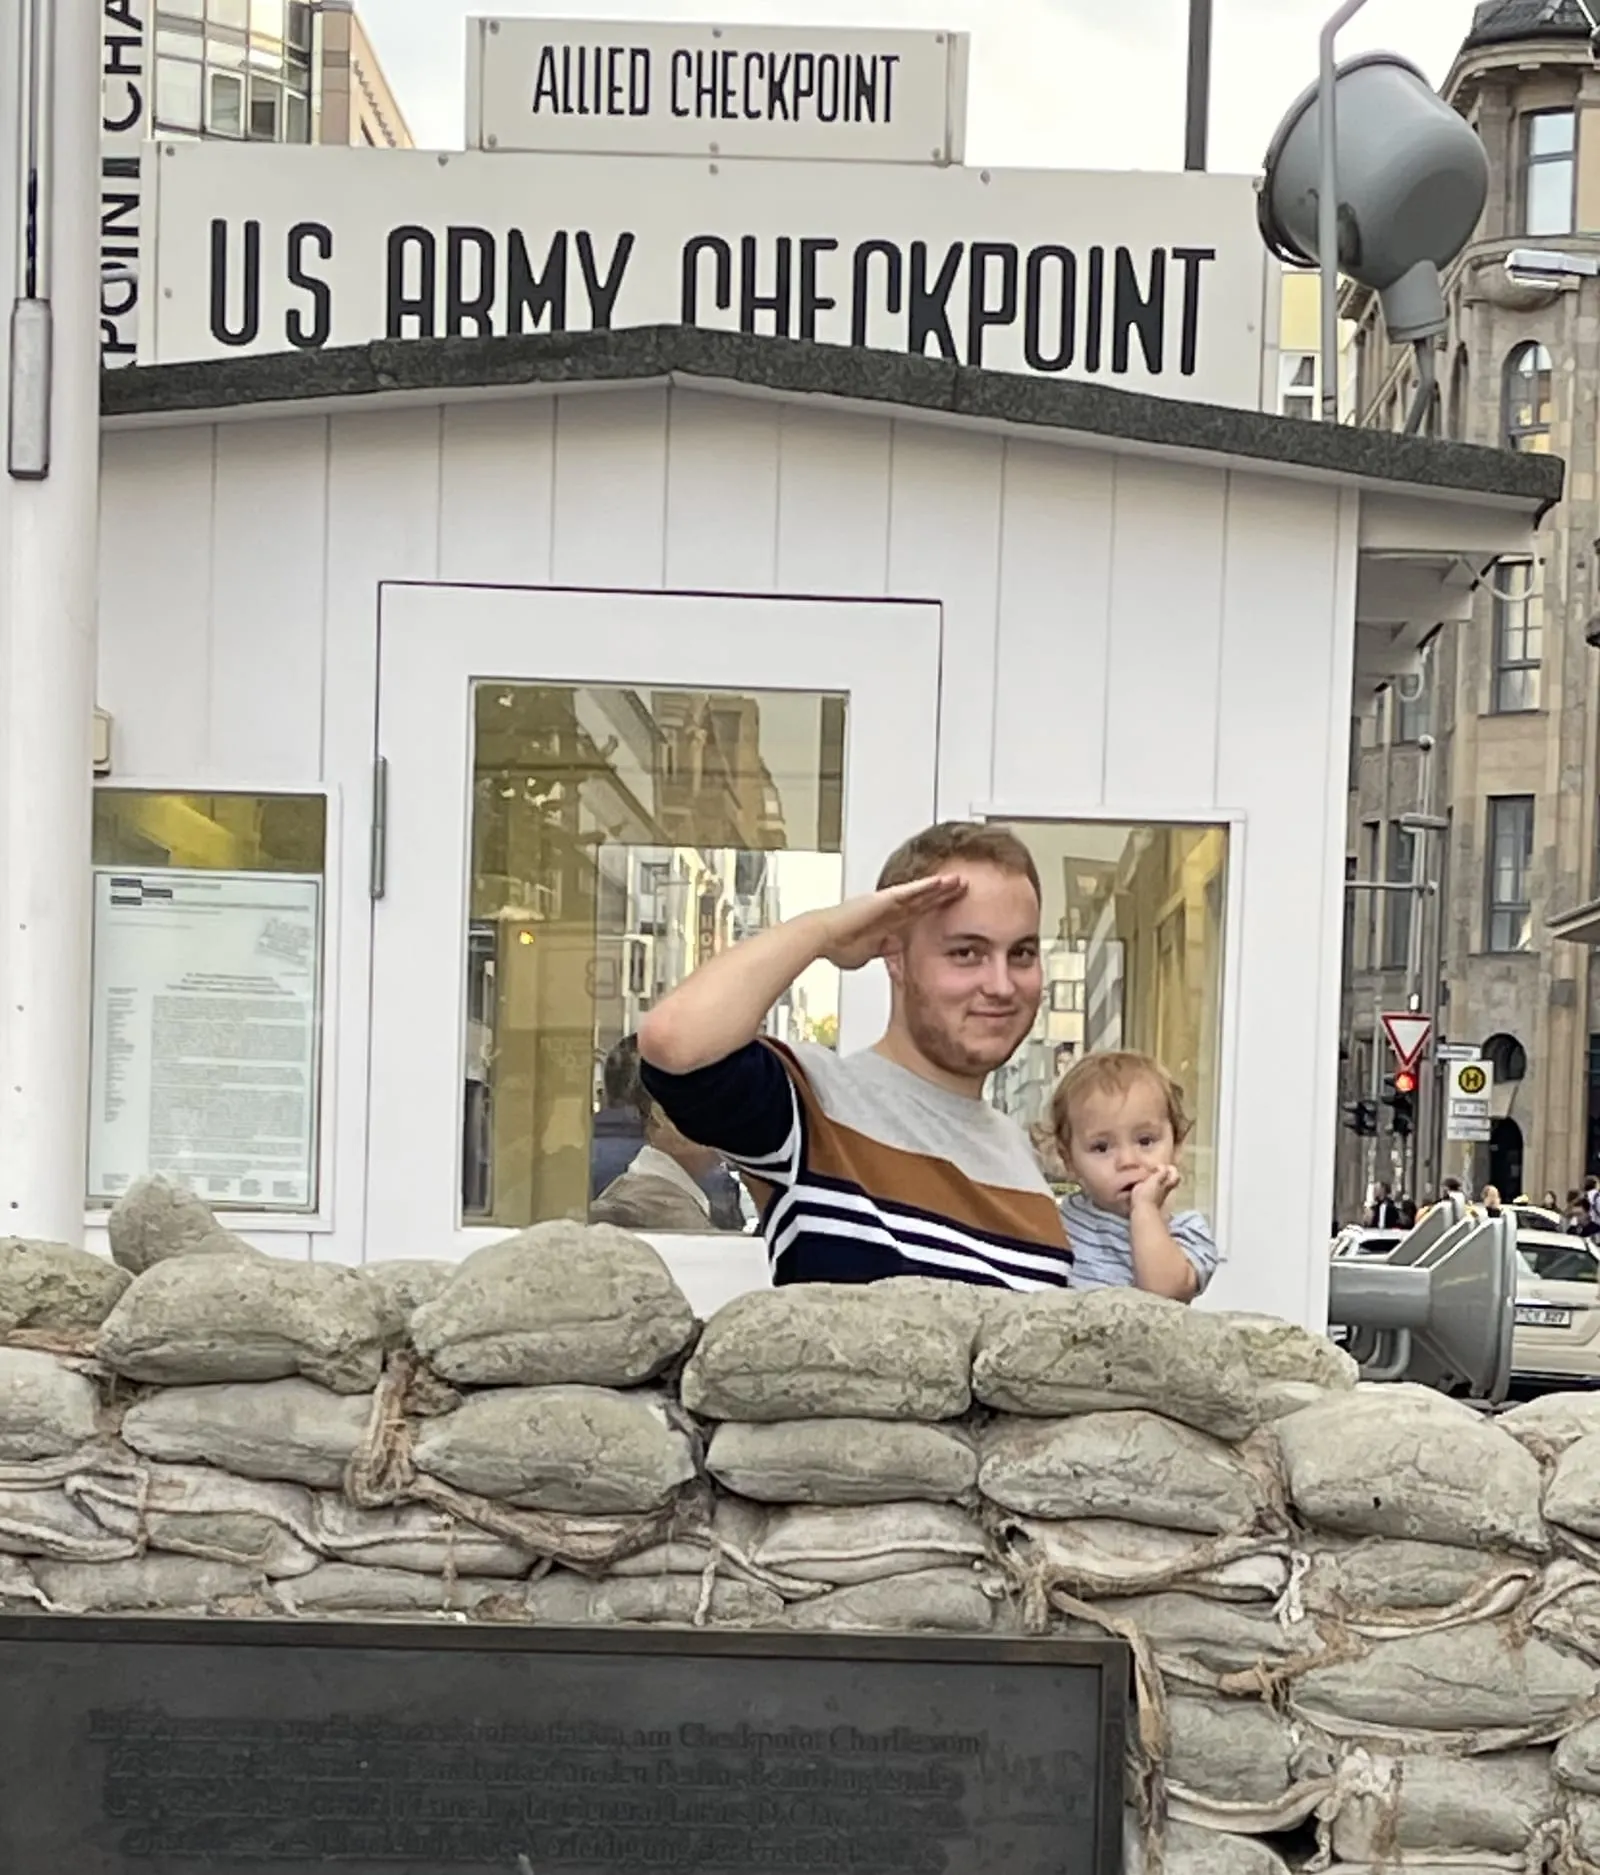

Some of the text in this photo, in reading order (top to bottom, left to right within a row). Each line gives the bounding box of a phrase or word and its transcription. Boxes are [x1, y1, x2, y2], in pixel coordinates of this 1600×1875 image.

[533, 46, 900, 123] ALLIED CHECKPOINT
[210, 219, 1216, 375] US ARMY CHECKPOINT
[632, 1729, 672, 1747] am
[679, 1721, 823, 1757] Checkpoint
[829, 1724, 922, 1752] Charlie
